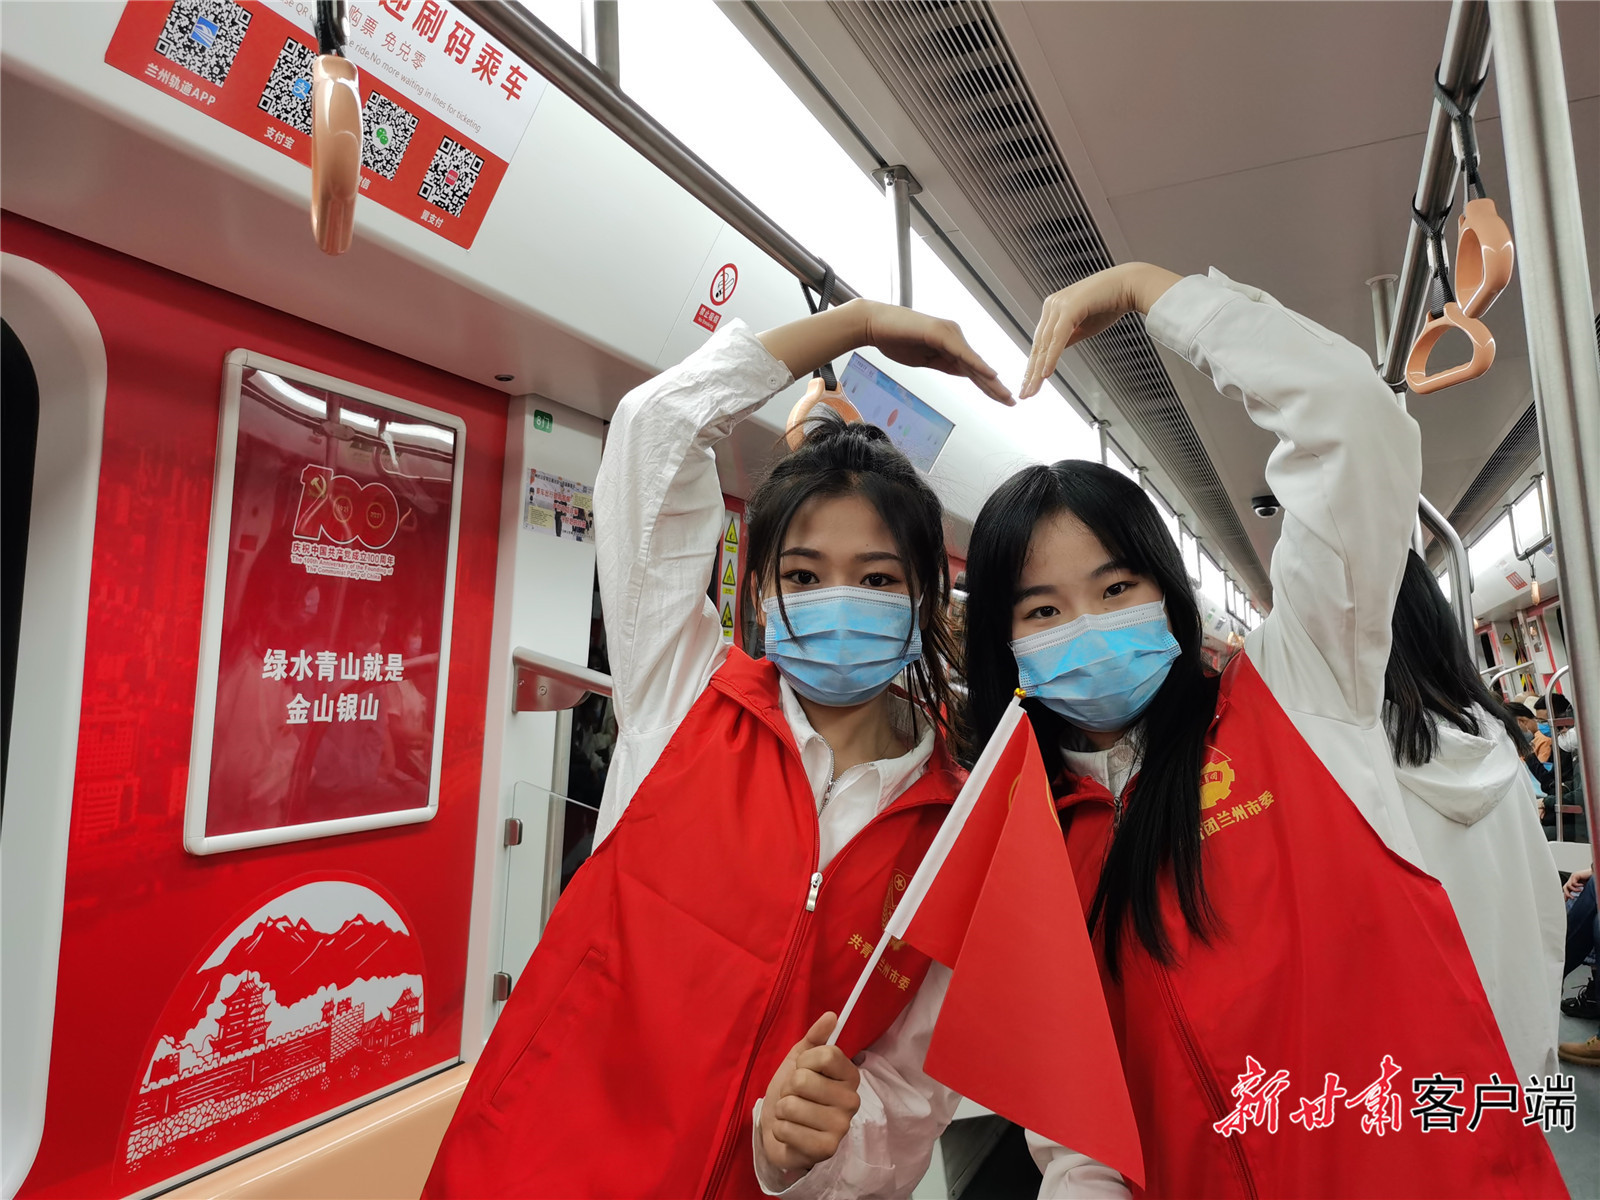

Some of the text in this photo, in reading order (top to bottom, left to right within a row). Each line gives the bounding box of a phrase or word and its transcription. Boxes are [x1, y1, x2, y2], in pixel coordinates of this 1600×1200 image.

[295, 2, 309, 17] QR
[381, 32, 426, 70] 免兑零
[144, 62, 217, 106] 兰州轨道APP
[381, 61, 400, 78] more
[400, 73, 424, 96] waiting
[432, 92, 447, 109] lines
[446, 104, 457, 115] for
[456, 110, 482, 133] ticketing
[263, 126, 296, 150] 支付宝
[292, 542, 395, 565] 庆祝中国共产党成立100周年
[261, 648, 405, 682] 绿水青山就是
[285, 692, 380, 725] 金山银山
[1200, 790, 1275, 840] 团兰州市委
[848, 933, 911, 991] 共青兰州市委
